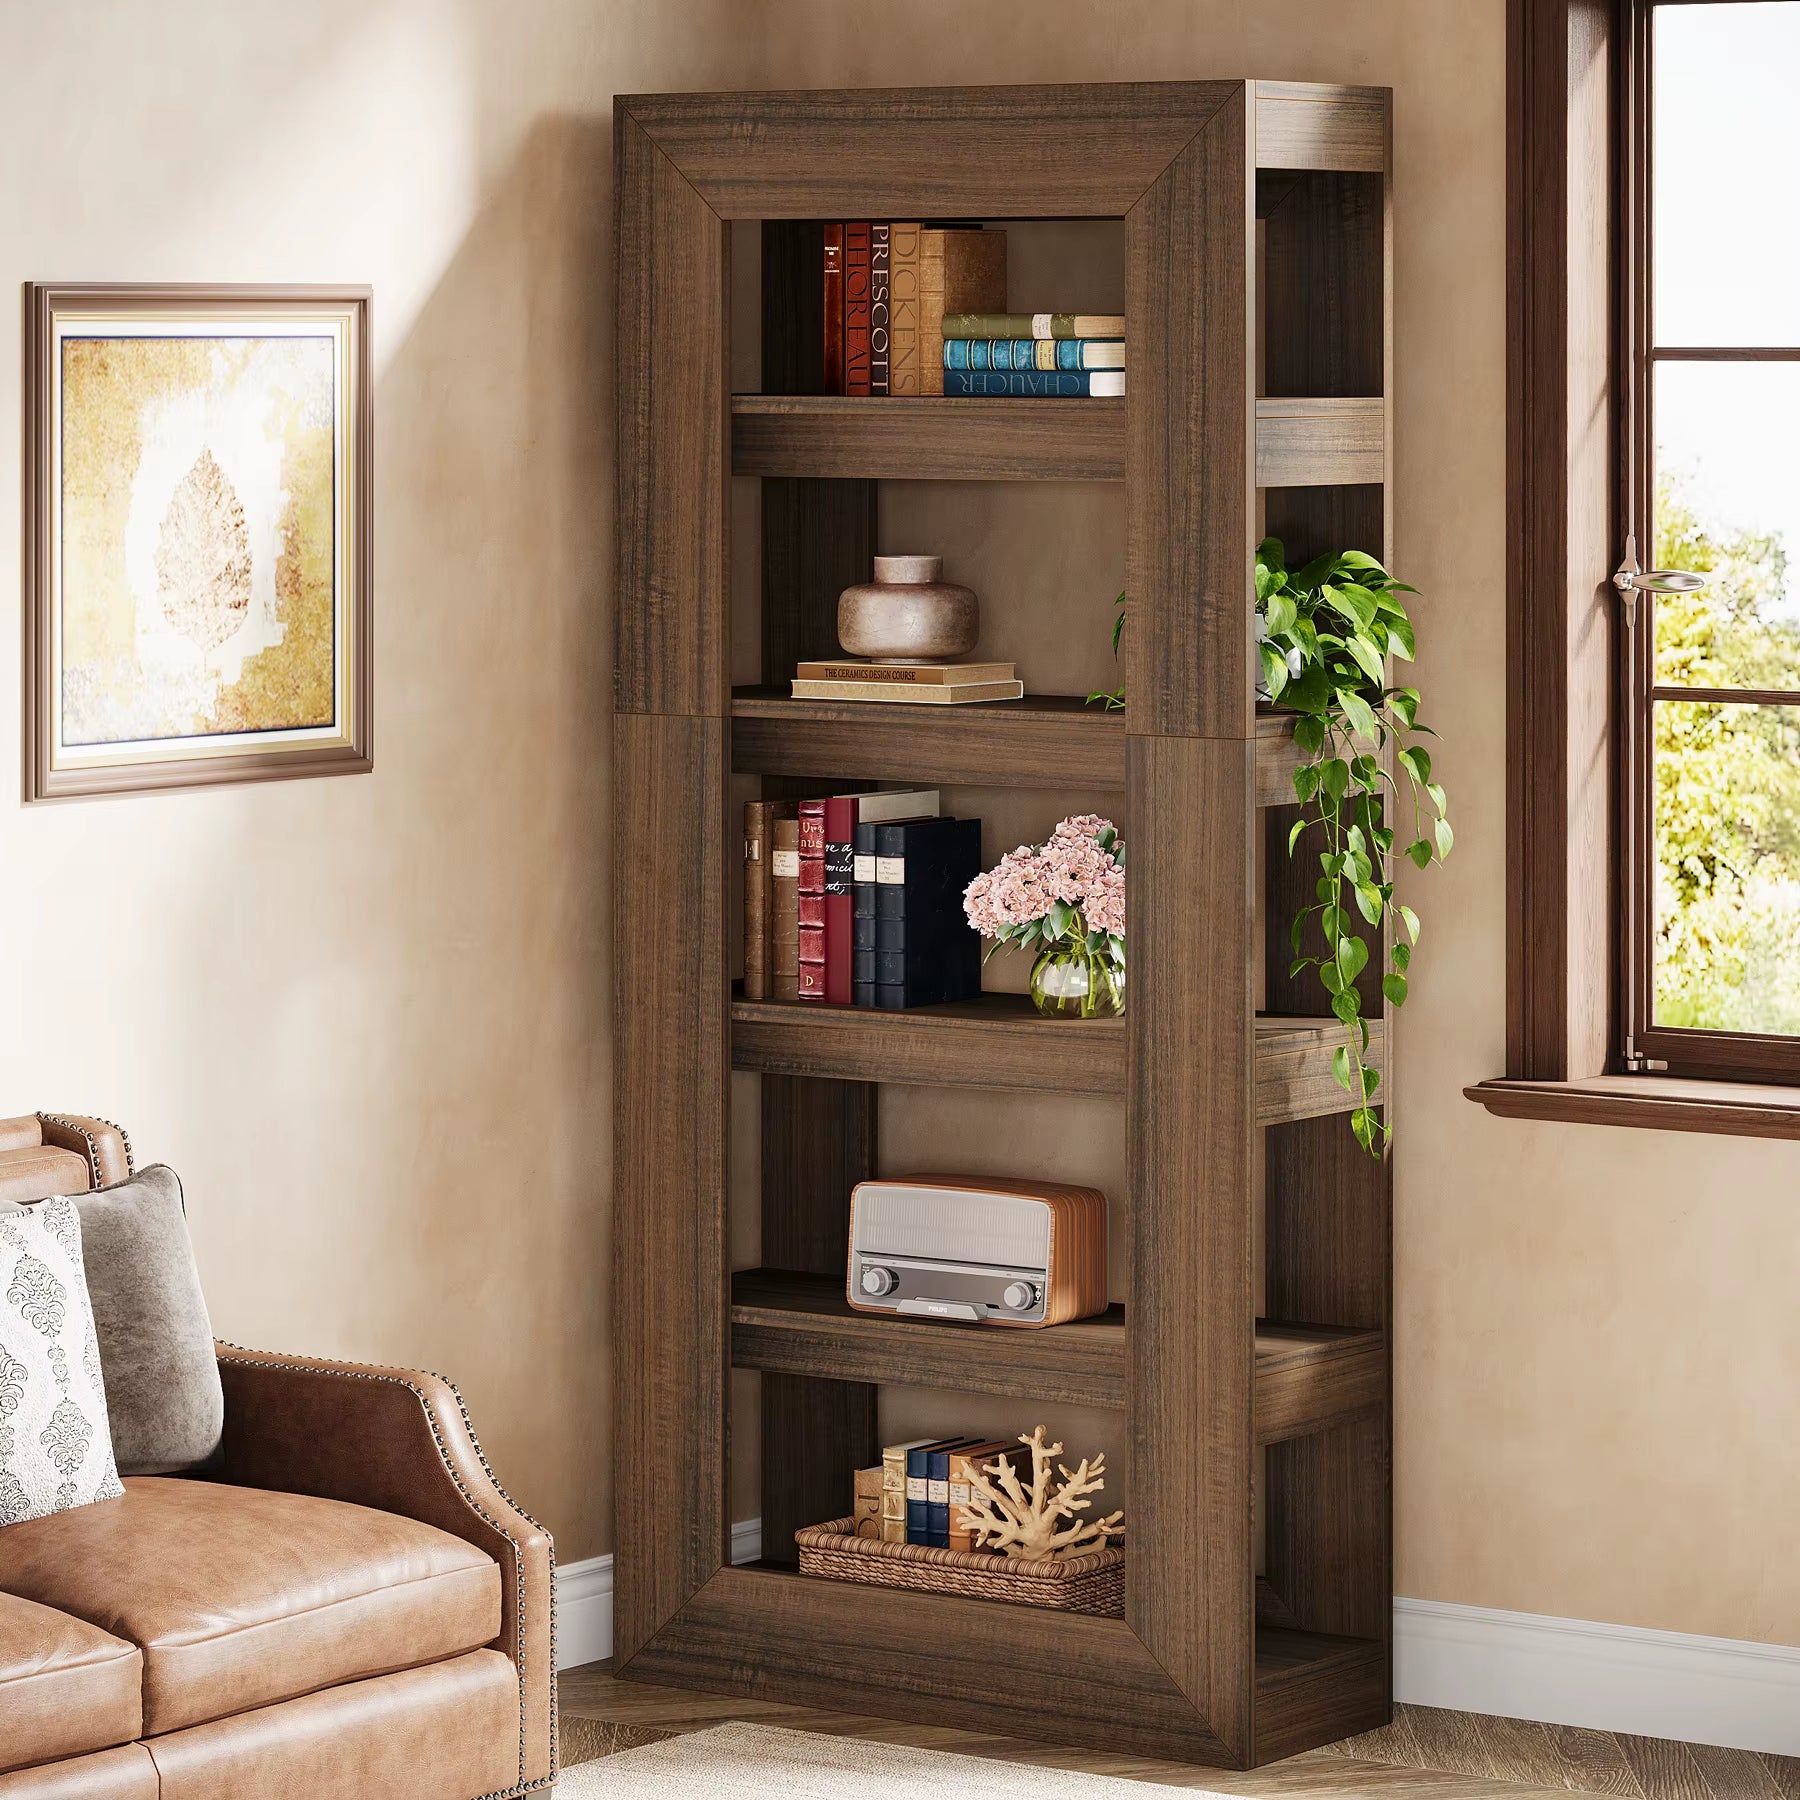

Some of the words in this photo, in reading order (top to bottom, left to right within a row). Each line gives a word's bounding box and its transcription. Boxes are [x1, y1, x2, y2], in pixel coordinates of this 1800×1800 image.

[847, 224, 868, 388] THOREAU
[871, 224, 889, 395] PRESCOTT
[893, 230, 918, 390] DICKENS
[956, 373, 1081, 395] CHAUCER
[824, 668, 837, 678] THE
[837, 668, 868, 679] CERAMICS
[869, 669, 891, 680] DESIGN
[892, 671, 916, 680] COURSE
[805, 975, 814, 987] D
